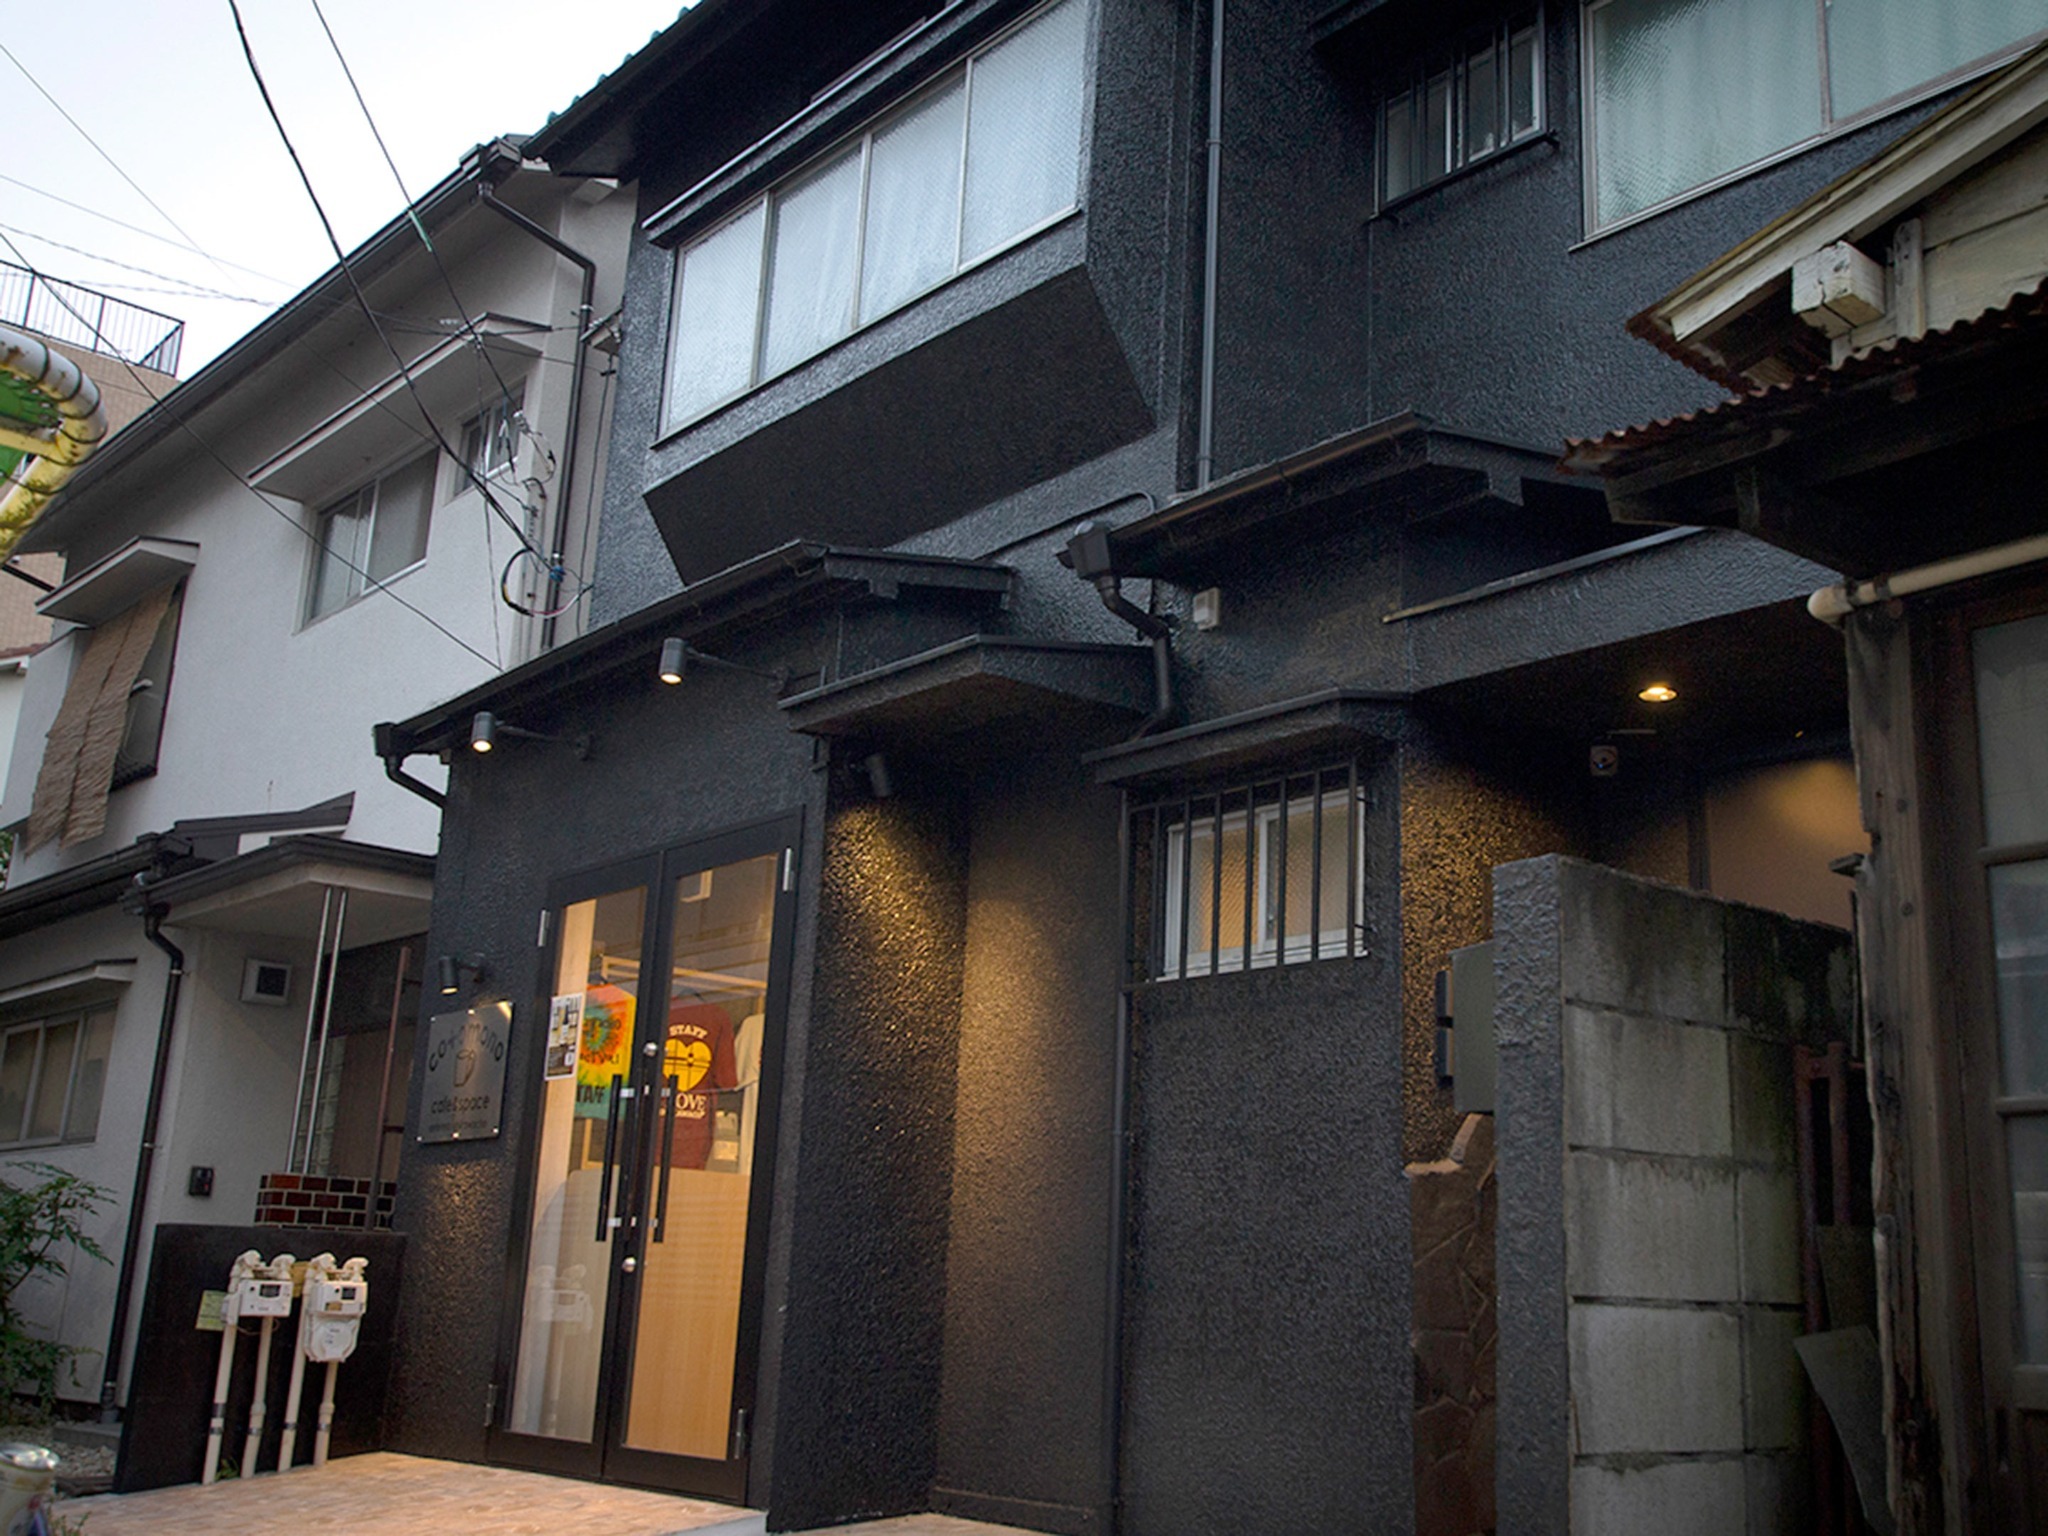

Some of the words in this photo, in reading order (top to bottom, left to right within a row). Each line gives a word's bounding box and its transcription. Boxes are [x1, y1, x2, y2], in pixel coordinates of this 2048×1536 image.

[669, 1024, 708, 1039] STAFF
[575, 1085, 606, 1103] TAFF
[674, 1092, 707, 1110] OVE
